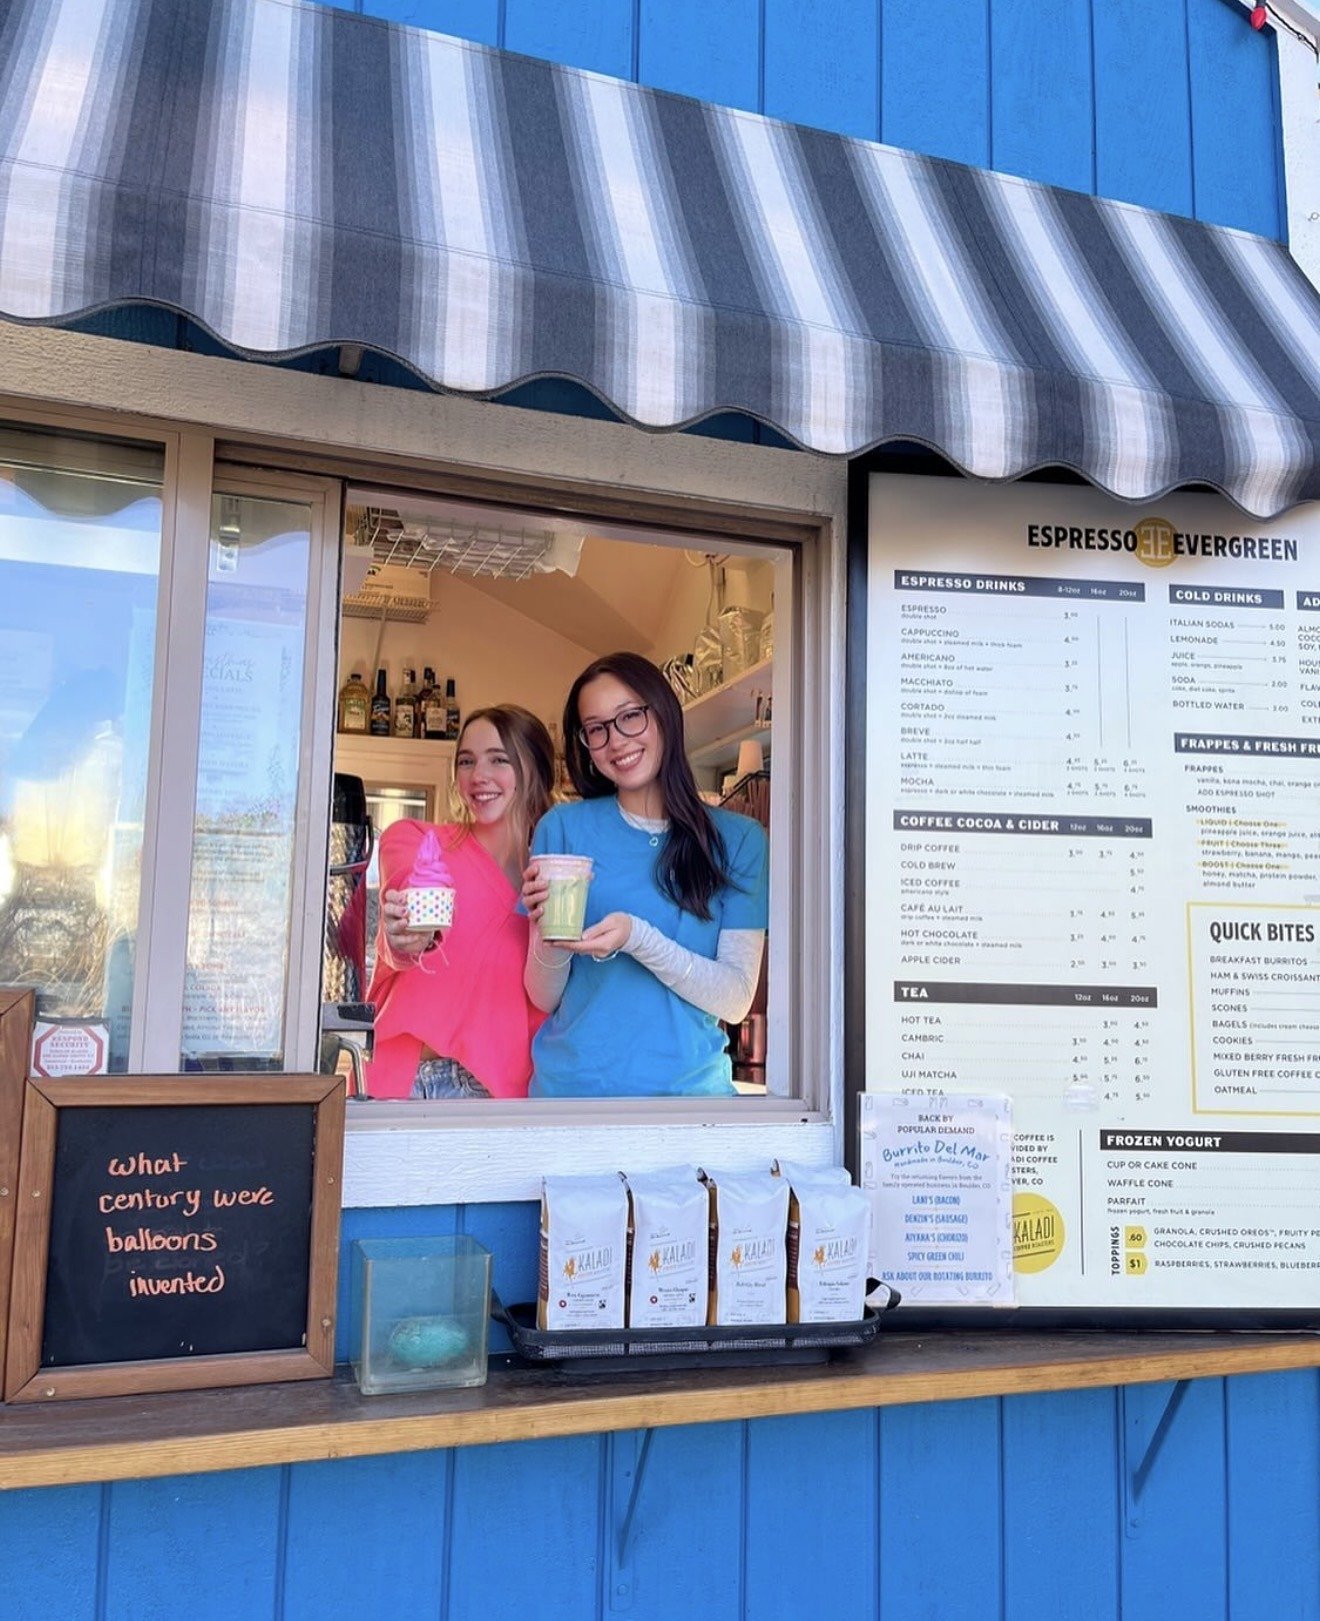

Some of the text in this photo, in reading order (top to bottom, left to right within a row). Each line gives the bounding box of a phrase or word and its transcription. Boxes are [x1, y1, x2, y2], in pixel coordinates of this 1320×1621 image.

[1028, 524, 1137, 551] ESPRESSO
[1173, 533, 1298, 561] EVERGREEN
[901, 576, 971, 589] ESPRESSO
[976, 580, 1026, 592] DRINKS
[1176, 590, 1262, 604] COLD DRINKS
[901, 605, 947, 613] ESPRESSO
[1170, 619, 1203, 627] ITALIAN
[901, 628, 959, 637] CAPPUCCINO
[1170, 635, 1218, 644] LEMONADE
[901, 653, 955, 662] AMERICANO
[901, 678, 953, 687] MACCHIATO
[1171, 676, 1196, 684] SODA
[901, 703, 945, 711] CORTADO
[1173, 700, 1244, 710] BOTTLED WATER
[901, 727, 930, 736] BREVE
[1181, 739, 1296, 752] FRAPPES & FRESH
[901, 753, 928, 761] LATTE
[1185, 765, 1223, 773] FRAPPES
[901, 778, 934, 786] MOCHA
[1186, 805, 1236, 814] SMOOTHIES
[900, 815, 952, 827] COFFEE
[957, 817, 1002, 829] COCOA
[1006, 819, 1014, 829] &
[1018, 819, 1059, 831] CIDER
[1125, 825, 1143, 833] 20oz
[901, 843, 960, 853] DRIP COFFEE
[901, 861, 955, 870] COLD BREW
[901, 879, 960, 887] ICED COFFEE
[901, 902, 963, 914] CAFÉ AU LAIT
[901, 930, 978, 939] HOT CHOCOLATE
[1210, 921, 1314, 943] QUICK BITES
[901, 956, 961, 965] APPLE CIDER
[1210, 955, 1308, 965] BREAKFAST BURRITOS
[1211, 972, 1231, 980] HAM
[1233, 972, 1239, 980] &
[1242, 972, 1269, 981] SWISS
[901, 987, 928, 998] TEA
[1102, 994, 1119, 1002] 16oz
[1211, 988, 1250, 996] MUFFINS
[1212, 1004, 1248, 1013] SCONES
[902, 1016, 941, 1025] HOT TEA
[1212, 1020, 1247, 1029] BAGELS
[902, 1034, 944, 1043] CAMBRIC
[1213, 1036, 1253, 1045] COOKIES
[902, 1052, 924, 1060] CHAI
[1213, 1053, 1305, 1063] MIXED BERRY FRESH
[902, 1070, 957, 1079] UJI MATCHA
[1214, 1070, 1312, 1079] GLUTEN FREE COFFEE
[1214, 1086, 1257, 1094] OATMEAL
[919, 1114, 940, 1122] BACK
[898, 1126, 974, 1134] POPULAR DEMAND
[1107, 1135, 1222, 1148] FROZEN YOGURT
[883, 1140, 990, 1162] Burrito Del Mar
[108, 1152, 188, 1178] what
[1107, 1161, 1198, 1170] CUP OR CAKE CONE
[1107, 1179, 1173, 1188] WAFFLE CONE
[99, 1187, 275, 1217] century were
[1107, 1197, 1146, 1206] PARFAIT
[1013, 1215, 1055, 1243] KALADI
[1154, 1227, 1197, 1236] GRANOLA,
[1199, 1228, 1238, 1236] CRUSHED
[1279, 1229, 1308, 1237] FRUITY
[105, 1227, 218, 1253] balloons
[1154, 1241, 1306, 1250] CHOCOLATE CHIPS, CRUSHED PECANS
[1111, 1226, 1120, 1276] TOPPINGS
[927, 1252, 946, 1261] GREEN
[1130, 1260, 1141, 1269] $1
[1155, 1260, 1212, 1269] RASPBERRIES,
[1214, 1261, 1278, 1270] STRAWBERRIES,
[129, 1265, 225, 1298] invented
